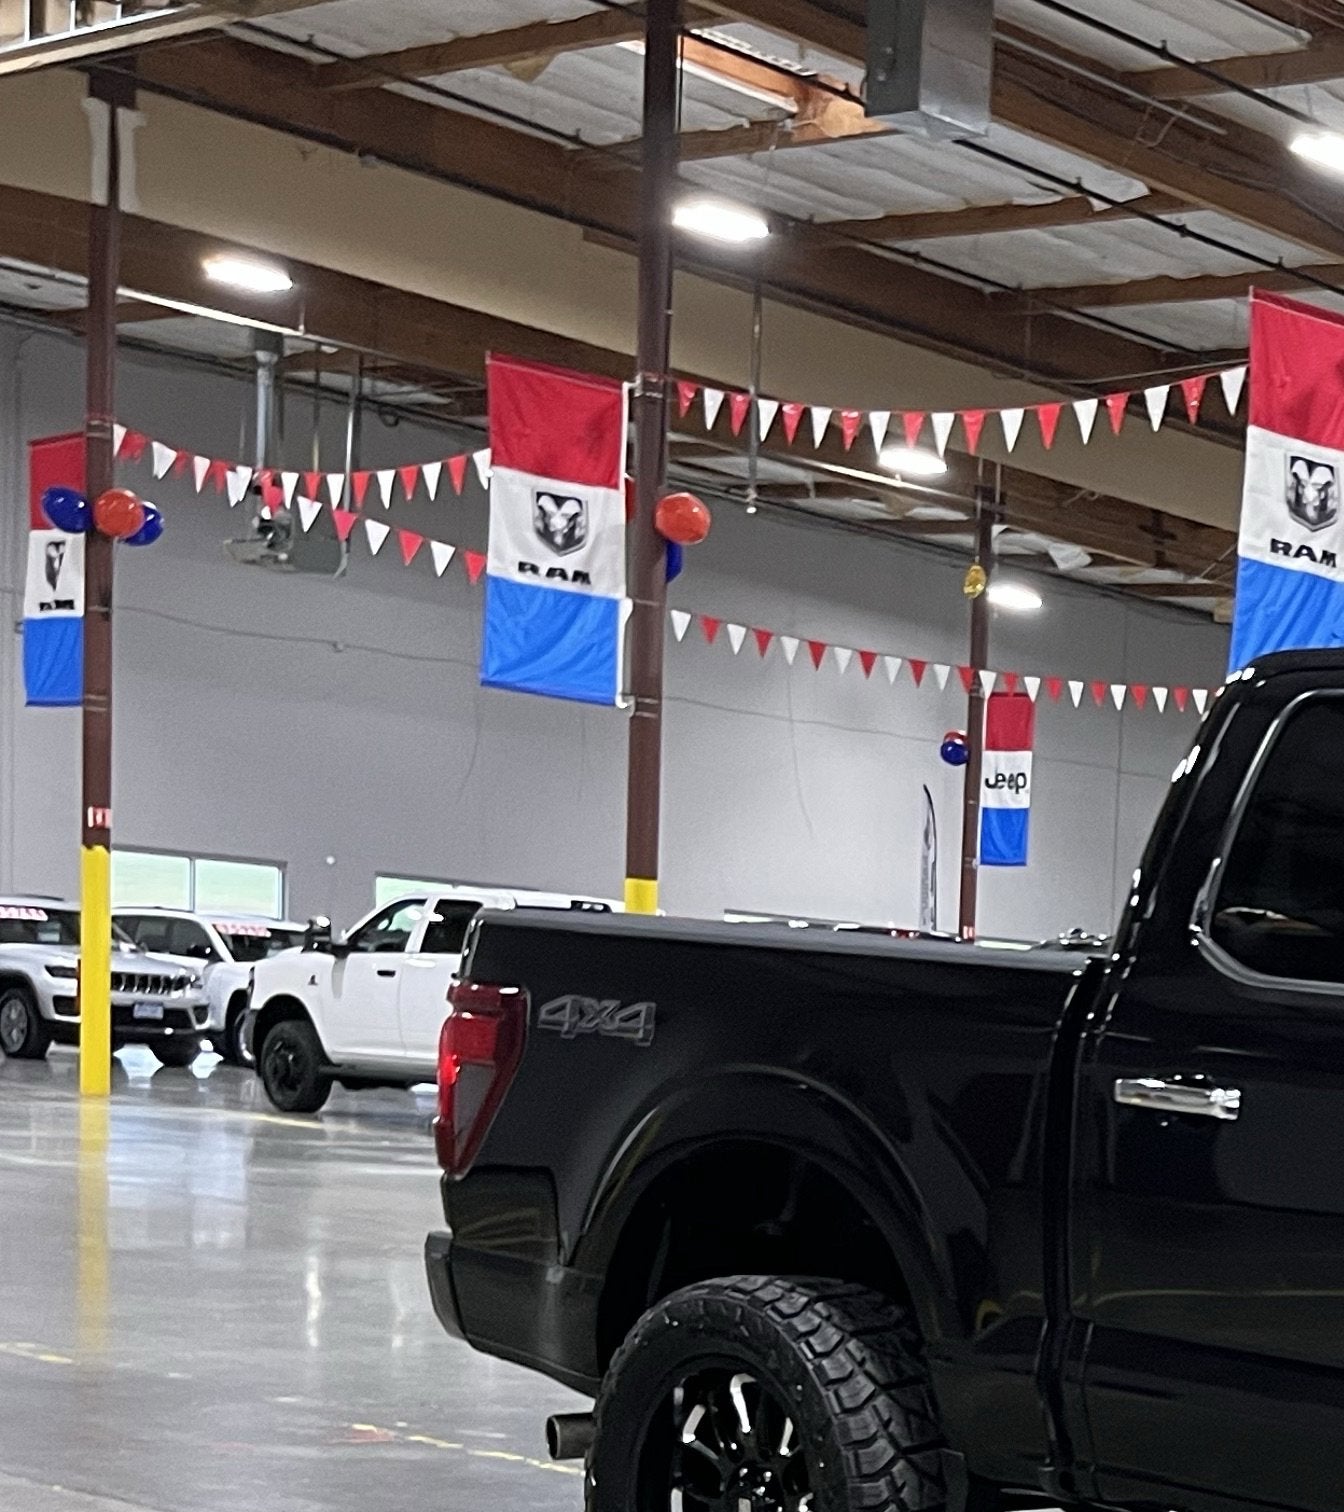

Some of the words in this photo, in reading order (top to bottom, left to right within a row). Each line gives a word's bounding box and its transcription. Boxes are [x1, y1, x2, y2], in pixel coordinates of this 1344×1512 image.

[1269, 538, 1336, 568] RAM
[518, 561, 591, 585] RAM
[985, 772, 1028, 795] Jeep
